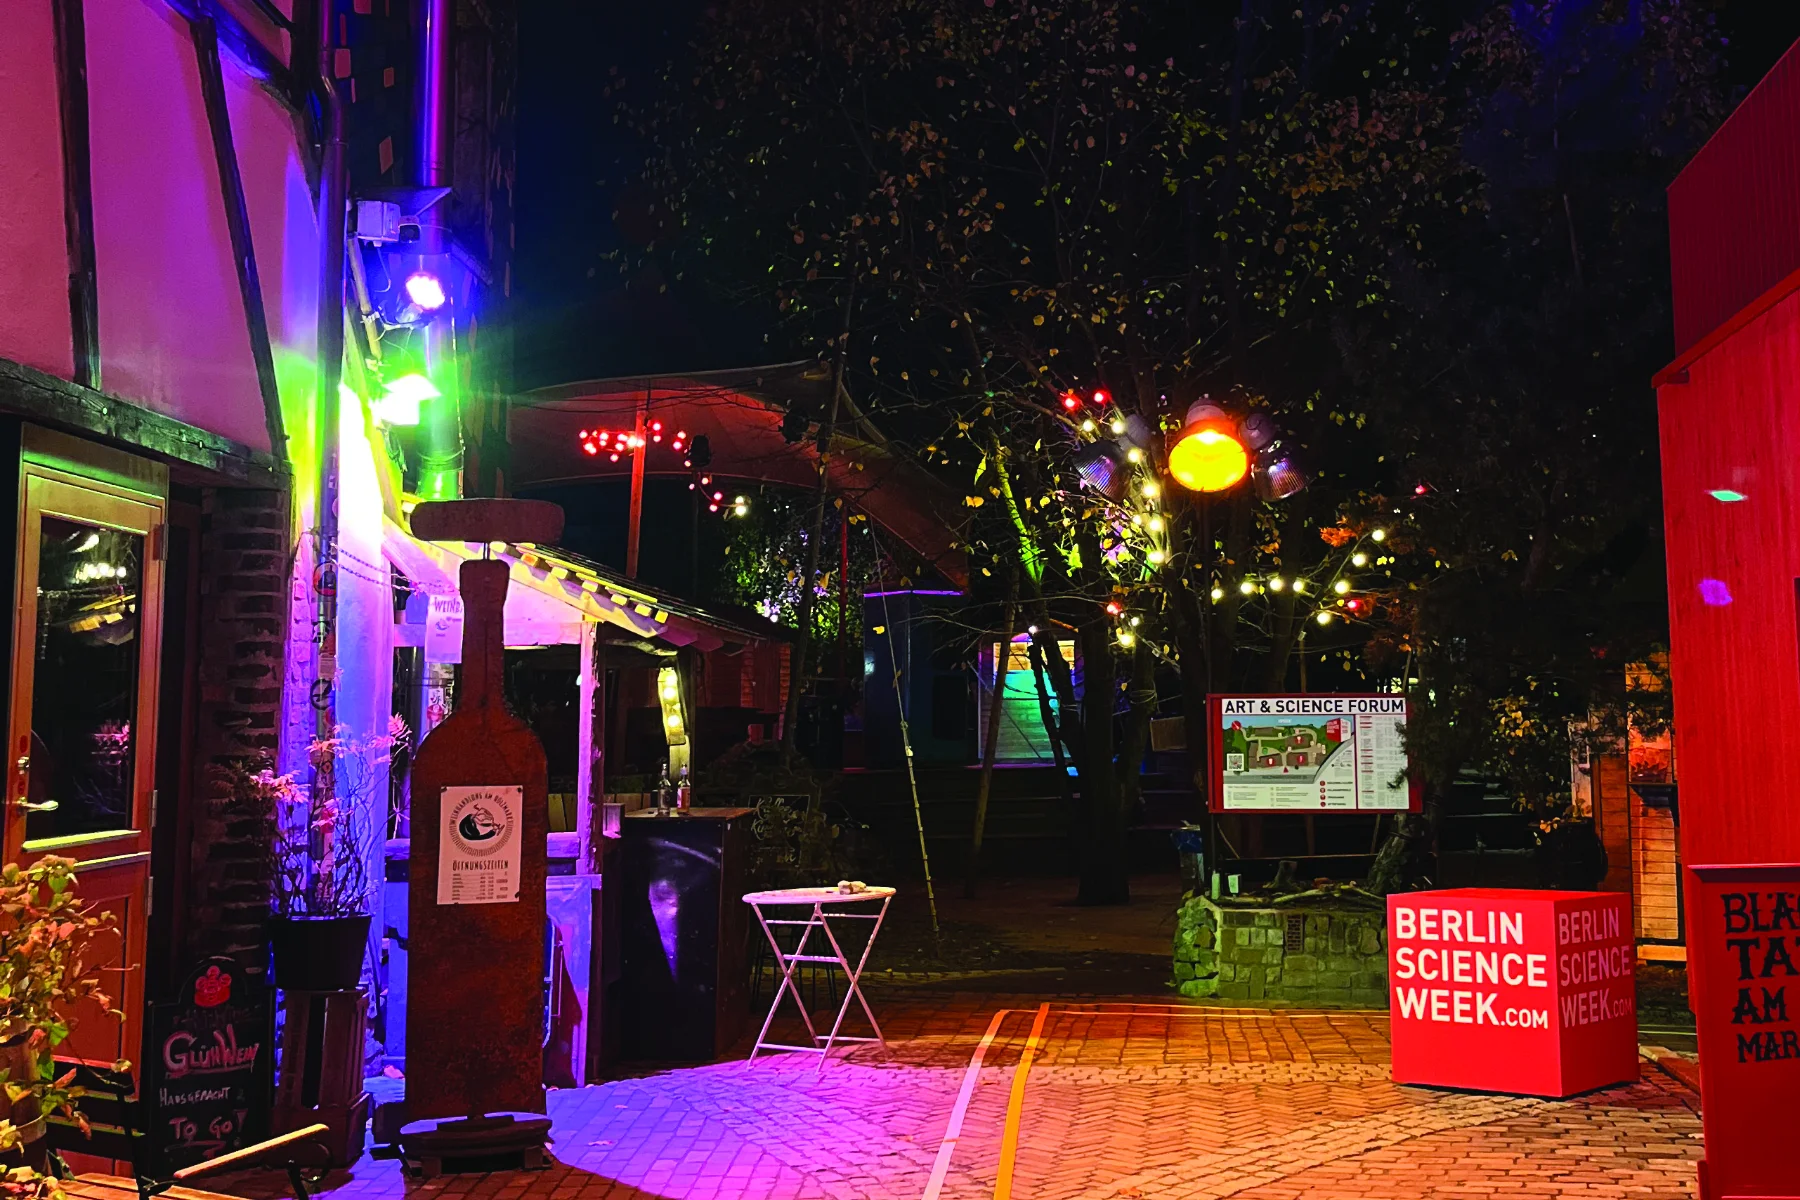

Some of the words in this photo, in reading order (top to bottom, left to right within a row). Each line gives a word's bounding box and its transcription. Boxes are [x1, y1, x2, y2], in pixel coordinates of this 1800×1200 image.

[434, 597, 463, 613] WEINB
[1225, 700, 1255, 713] ART
[1260, 700, 1271, 713] &
[1276, 700, 1343, 713] SCIENCE
[1349, 699, 1404, 713] FORUM
[453, 860, 508, 871] ÖFFNUNGSZEITEN
[1396, 907, 1524, 945] BERLIN
[1559, 907, 1619, 945] BERLIN
[1720, 892, 1800, 934] BLÄ
[1396, 948, 1548, 988] SCIENCE
[1560, 945, 1631, 987] SCIENCE
[1726, 937, 1800, 981] TA
[1731, 986, 1789, 1024] AM
